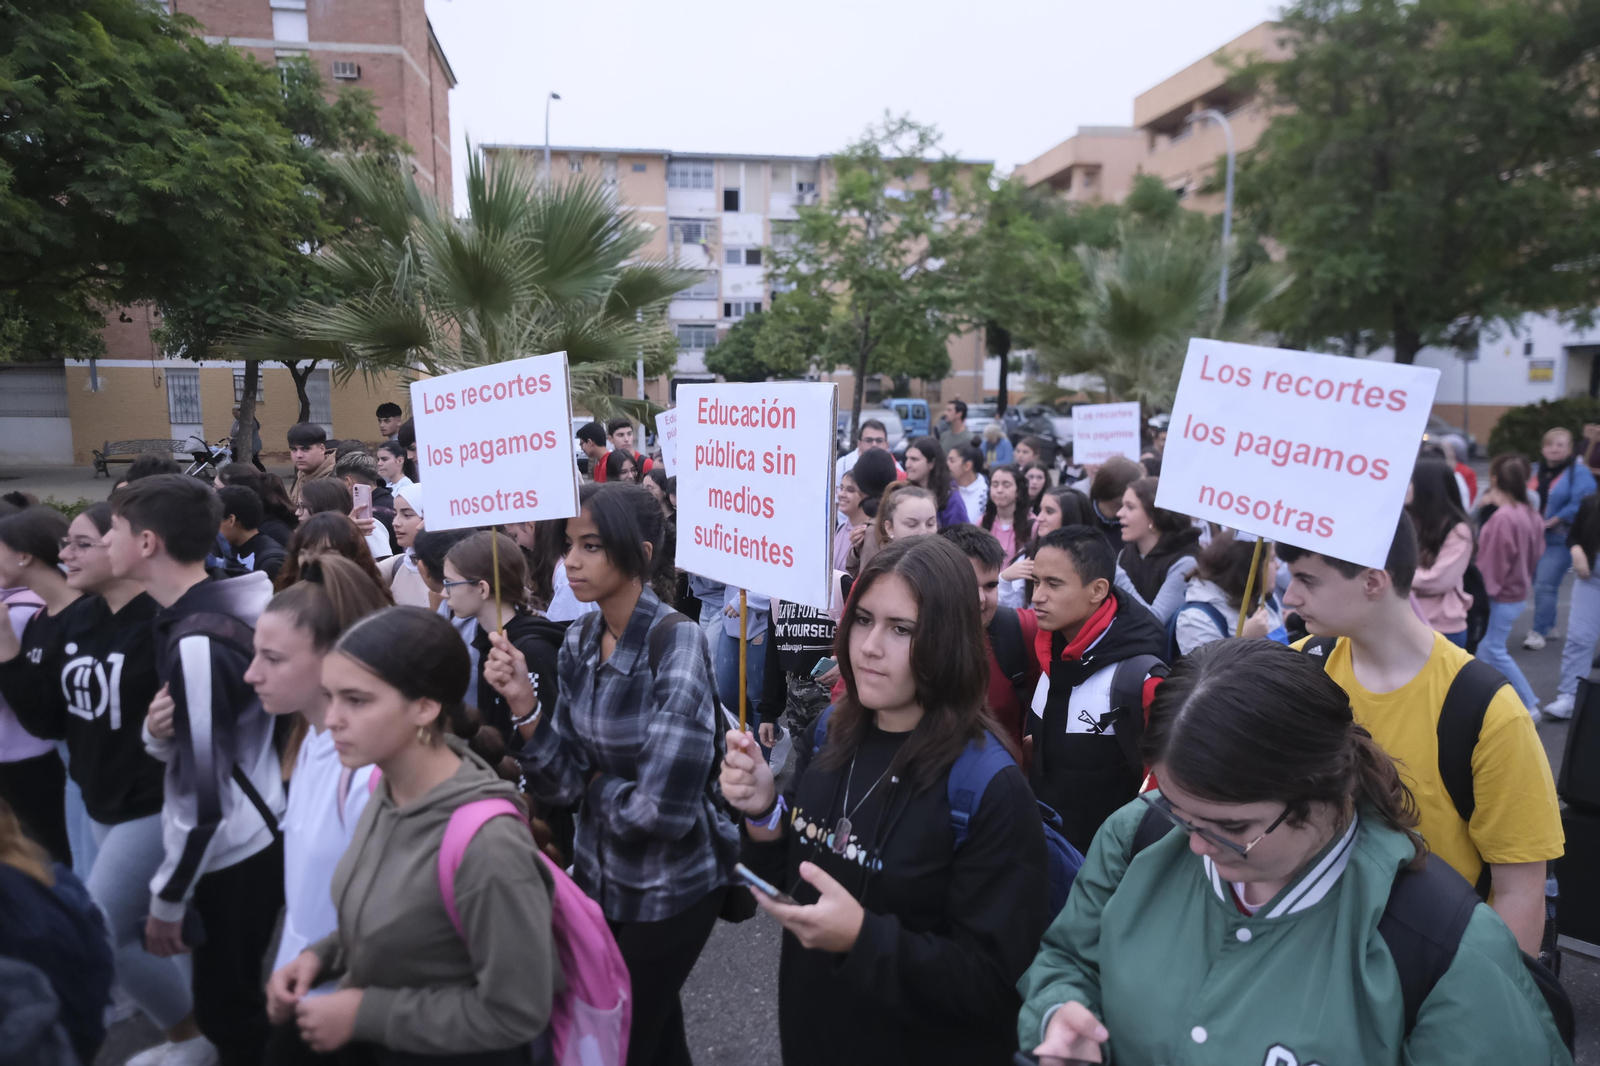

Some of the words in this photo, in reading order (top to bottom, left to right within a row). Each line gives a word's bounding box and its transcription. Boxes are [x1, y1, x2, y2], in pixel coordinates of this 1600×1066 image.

[423, 392, 456, 415] Los
[461, 373, 551, 407] recortes
[1199, 355, 1252, 387] Los
[1262, 370, 1408, 412] recortes
[697, 397, 797, 430] Educación
[427, 444, 454, 467] los
[459, 430, 557, 468] pagamos
[695, 439, 756, 472] pública
[762, 444, 796, 476] sin
[1183, 413, 1226, 446] los
[1234, 430, 1390, 481] pagamos
[449, 489, 539, 516] nosotras
[708, 485, 775, 519] medios
[1198, 485, 1335, 538] nosotras
[694, 522, 795, 568] suficientes
[778, 603, 797, 619] HAVE
[797, 604, 818, 619] FUN
[786, 623, 837, 638] YOURSELF
